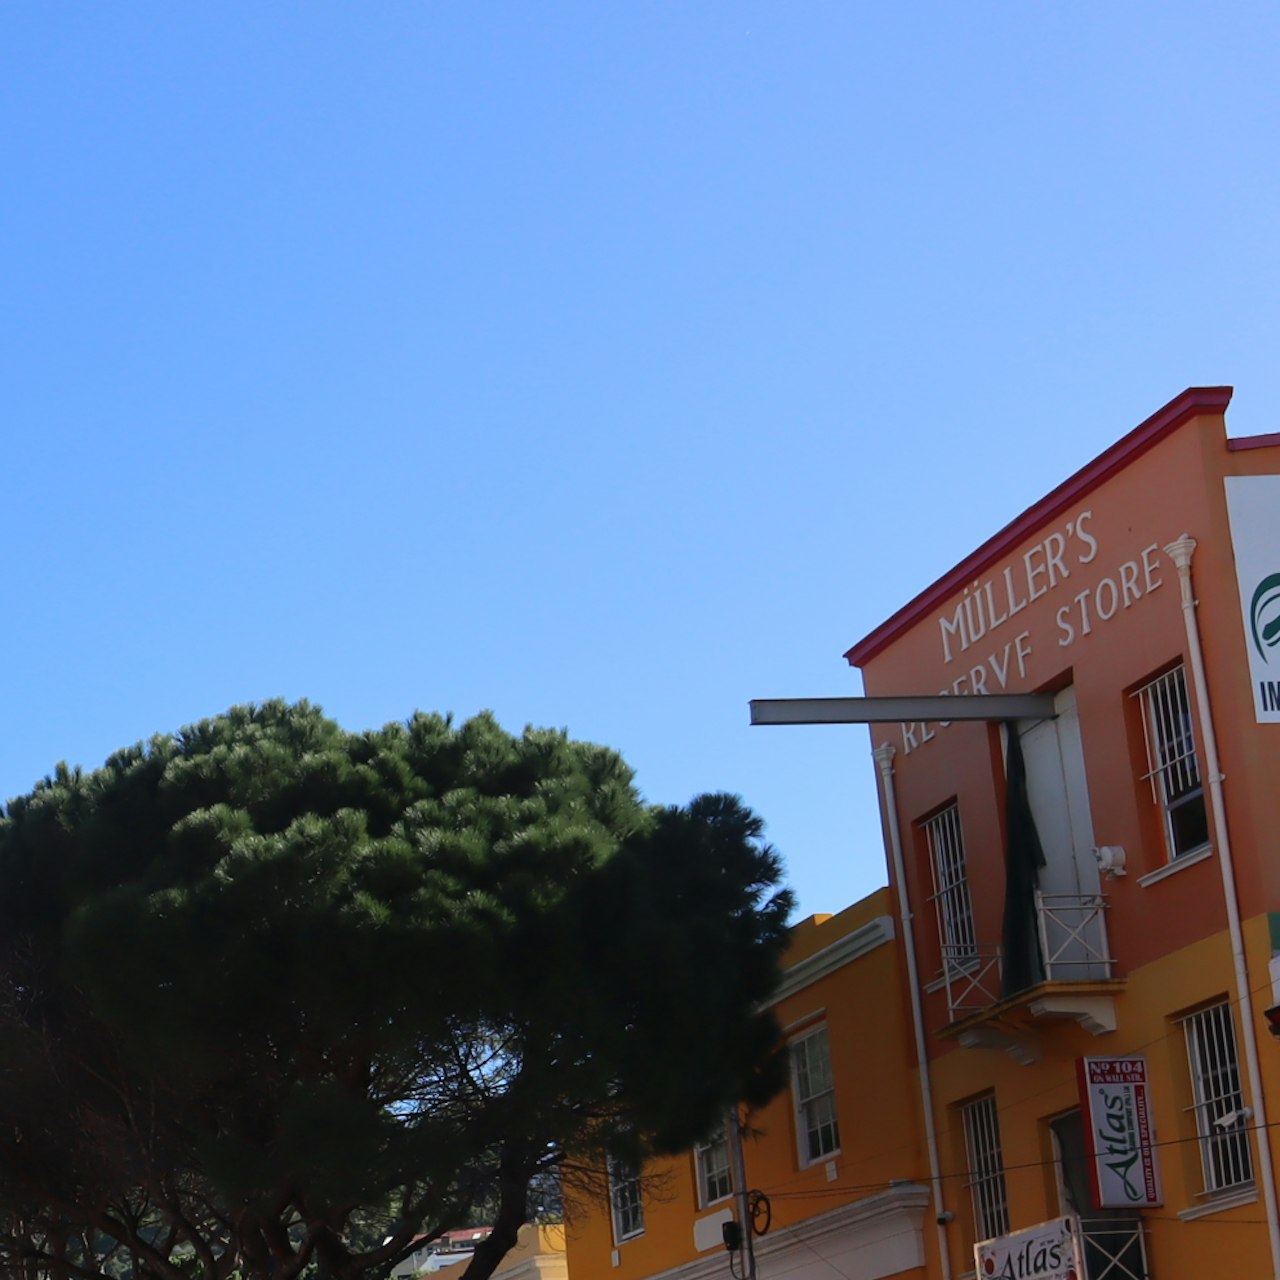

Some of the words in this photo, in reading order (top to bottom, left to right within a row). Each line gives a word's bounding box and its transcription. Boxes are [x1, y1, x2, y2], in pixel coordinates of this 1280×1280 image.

[938, 510, 1098, 664] MÜLLER'S
[1056, 543, 1164, 647] STORE
[1113, 1061, 1144, 1073] 104
[1099, 1091, 1144, 1201] Atlas
